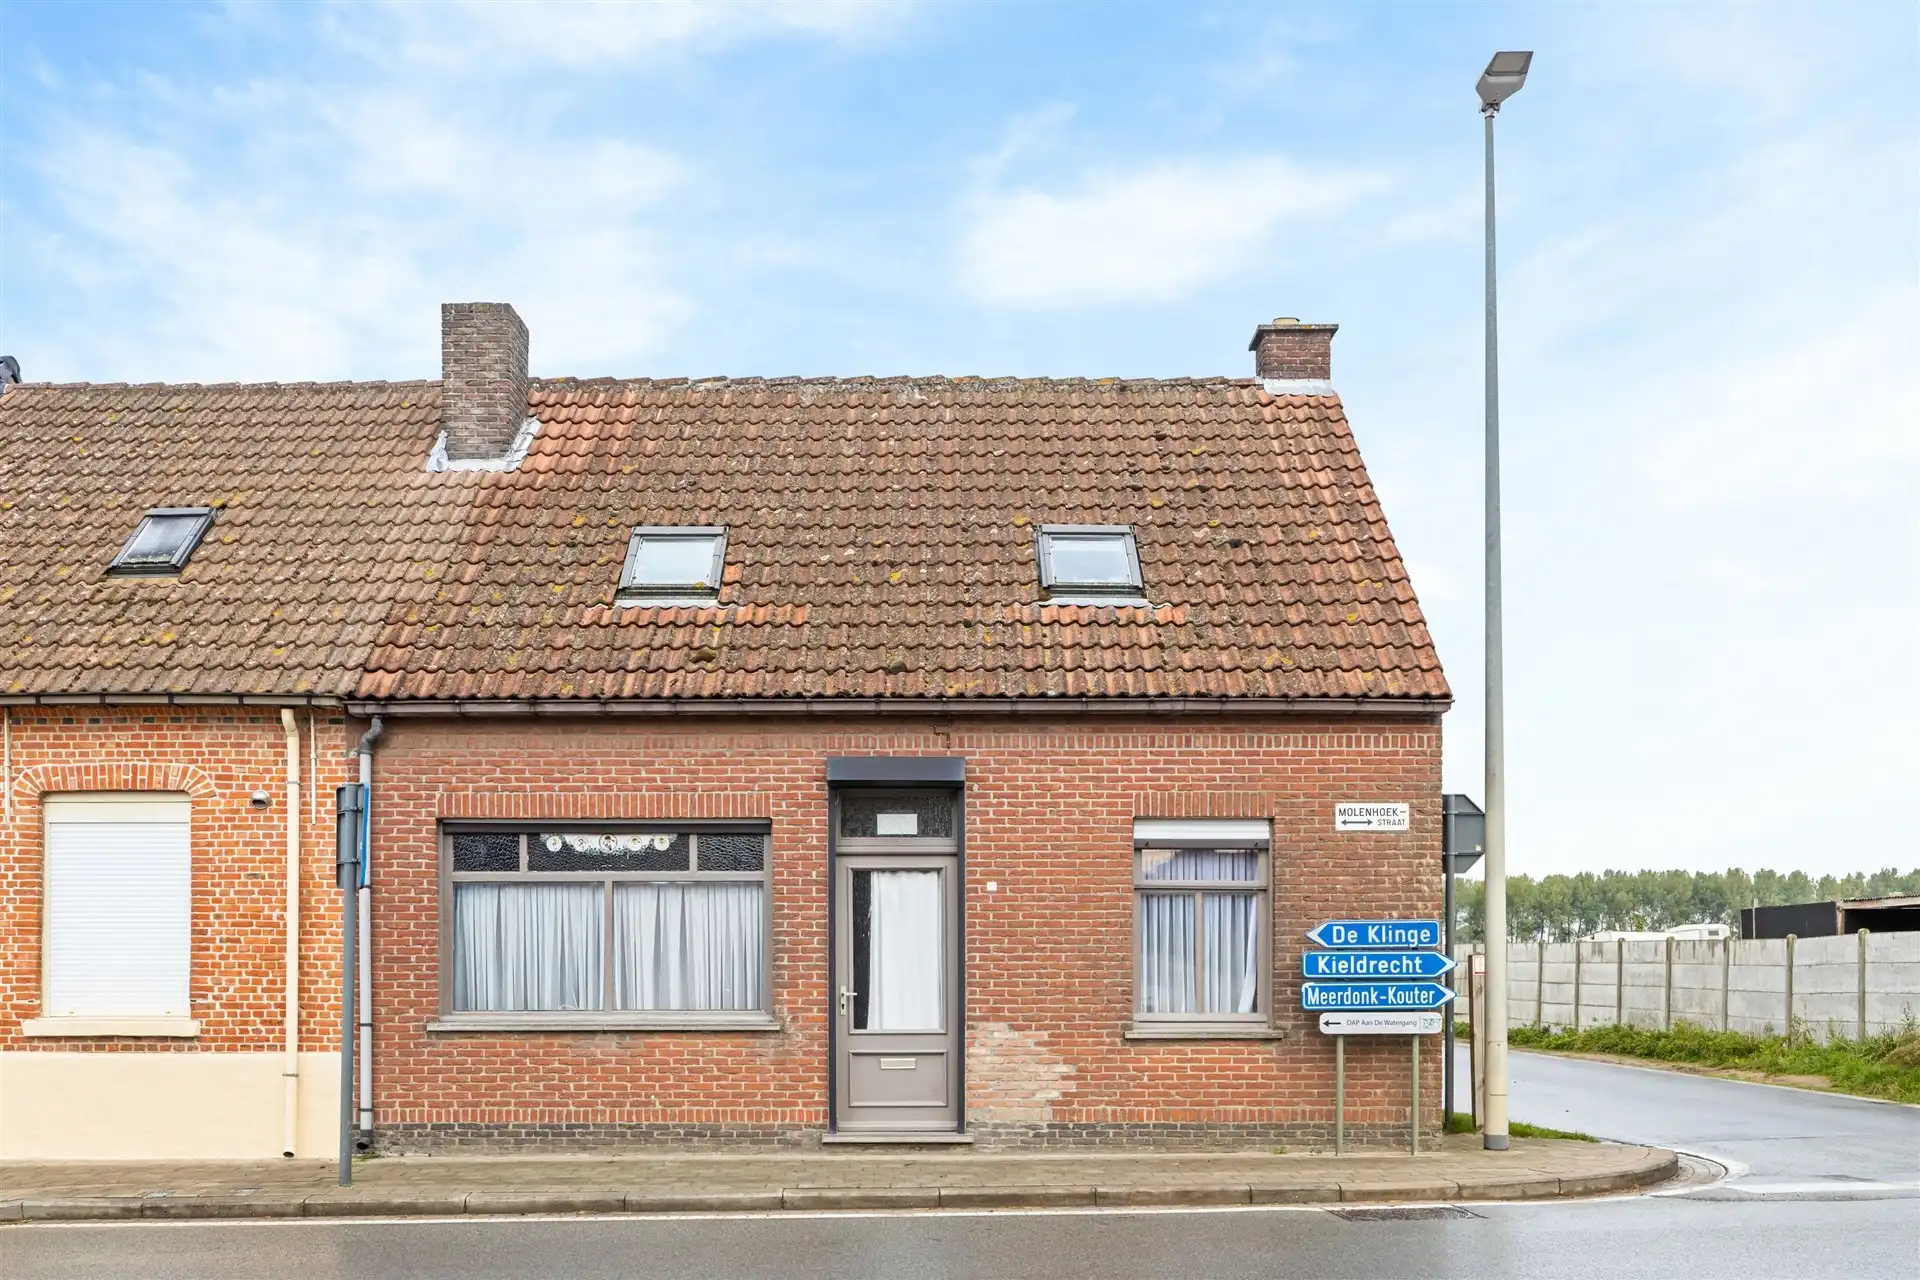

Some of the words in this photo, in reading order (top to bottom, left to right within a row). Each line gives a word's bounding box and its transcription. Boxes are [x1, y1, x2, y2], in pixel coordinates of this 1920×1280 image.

[1338, 807, 1406, 817] MOLENHOEK-
[1377, 818, 1405, 826] STRAAT
[1332, 925, 1358, 943] De
[1368, 925, 1431, 947] Klinge
[1318, 955, 1423, 974] Kieldrecht
[1307, 986, 1435, 1005] Meerdonk-Kouter
[1383, 1019, 1417, 1028] Watergang
